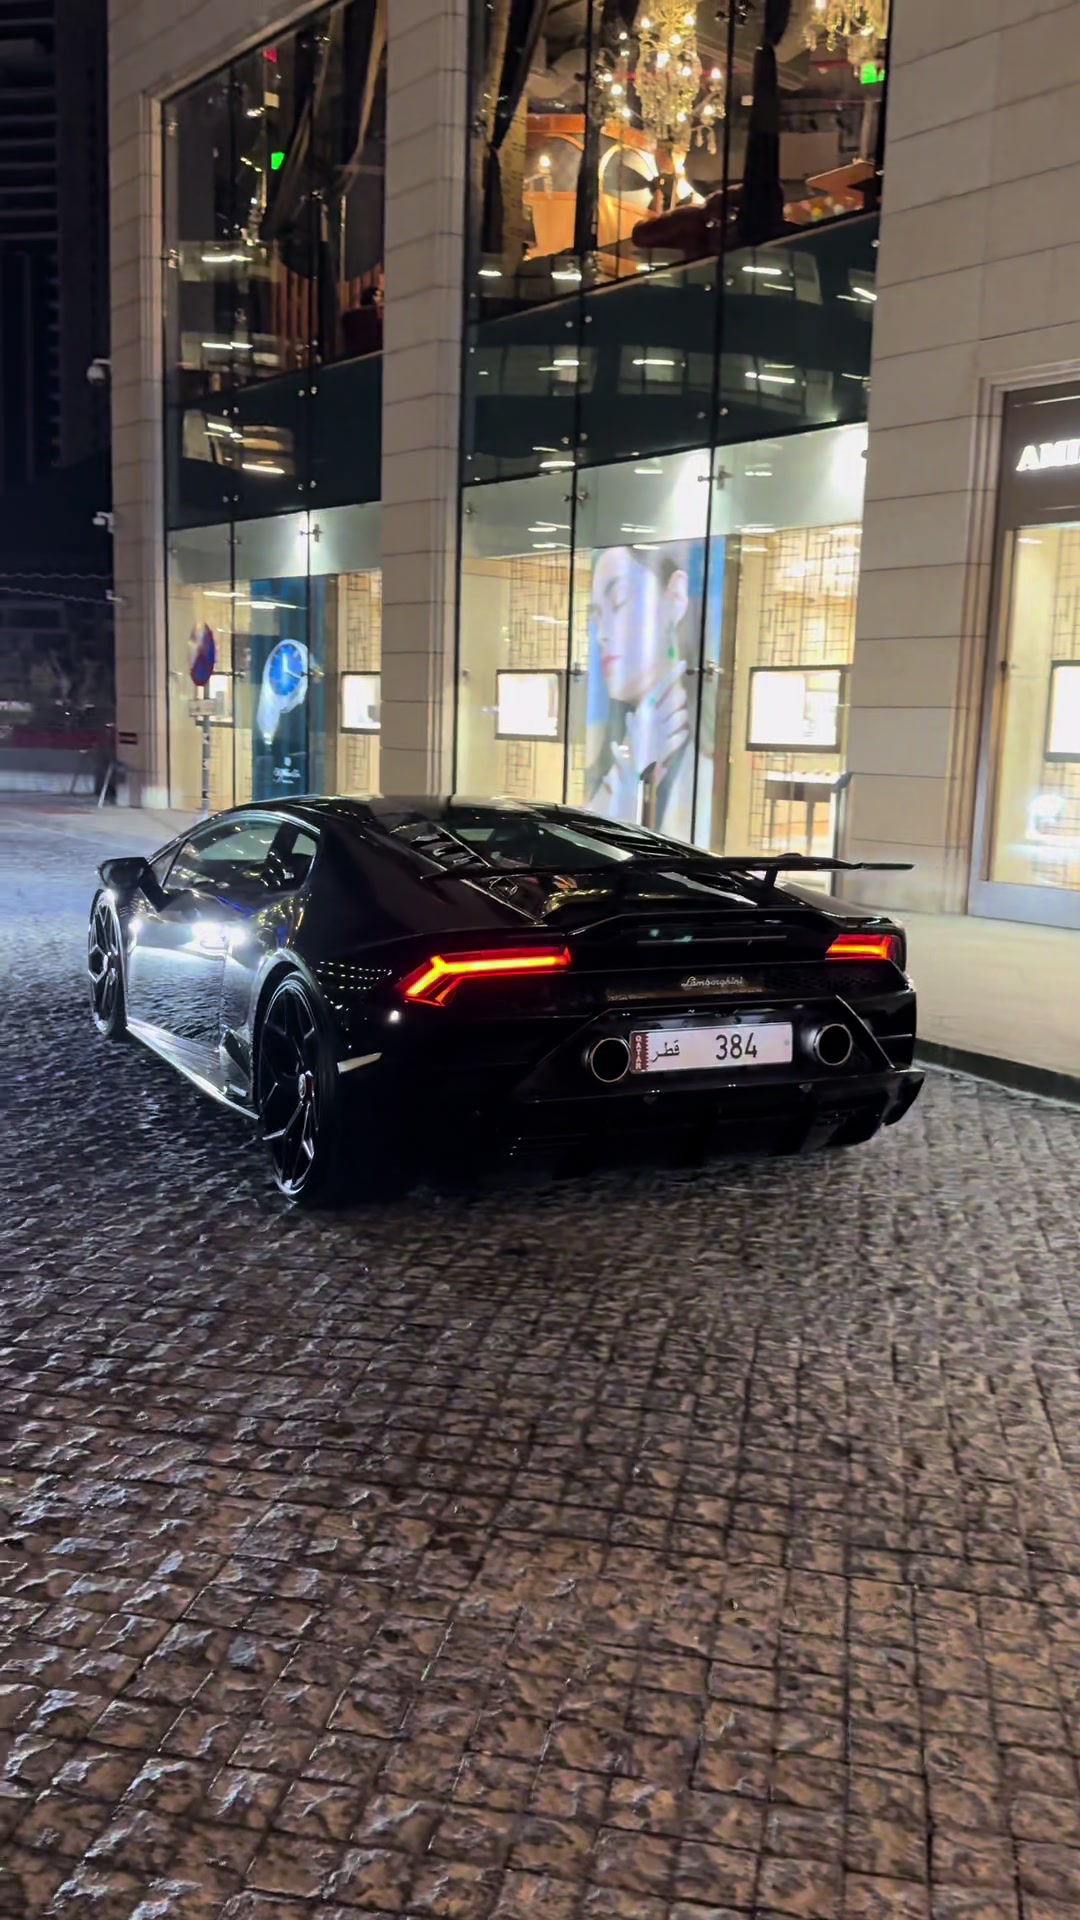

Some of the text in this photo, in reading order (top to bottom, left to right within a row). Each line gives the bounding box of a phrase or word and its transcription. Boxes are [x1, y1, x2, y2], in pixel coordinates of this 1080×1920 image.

[680, 975, 744, 988] Lamborghini
[634, 1035, 643, 1070] QATAR
[650, 1039, 681, 1062] قطر
[715, 1032, 758, 1061] 384
